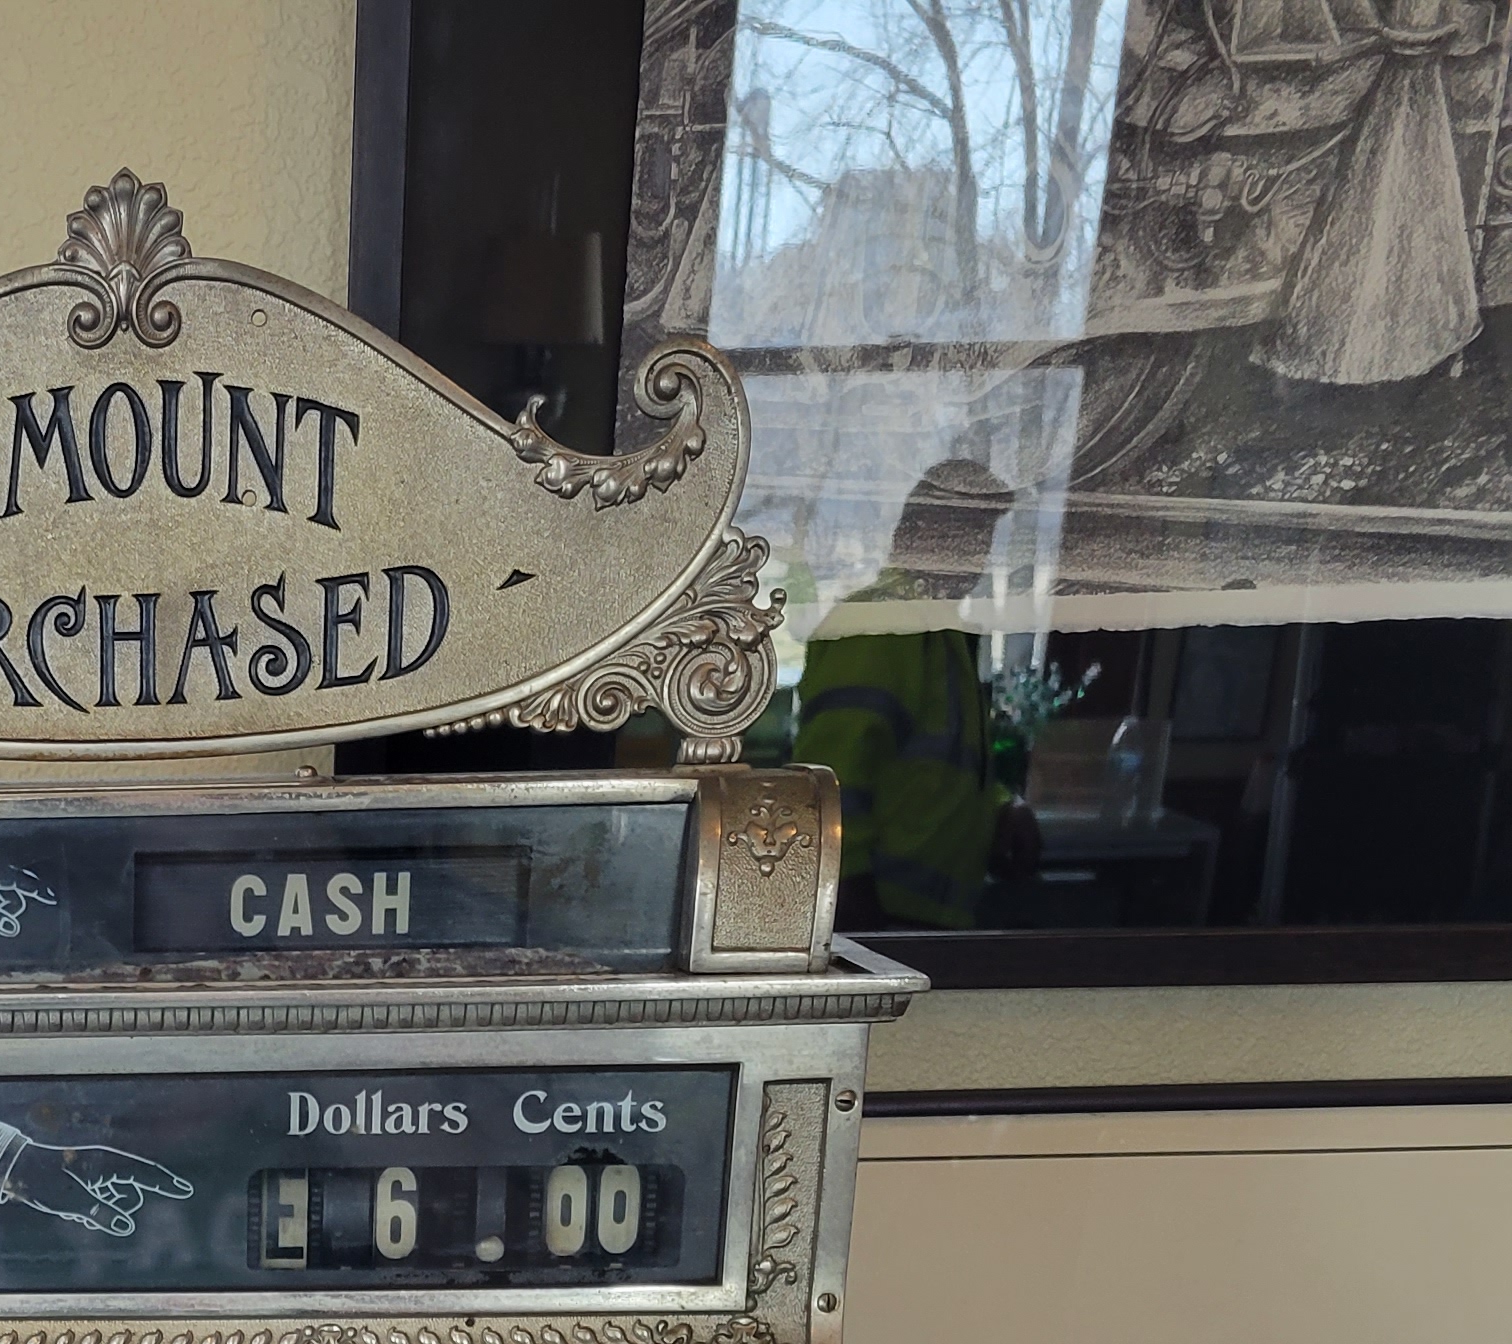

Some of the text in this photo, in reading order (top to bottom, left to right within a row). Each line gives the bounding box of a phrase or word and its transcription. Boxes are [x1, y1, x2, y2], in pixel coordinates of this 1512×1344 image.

[230, 871, 411, 937] CASH
[287, 1089, 667, 1135] Dollars Cents
